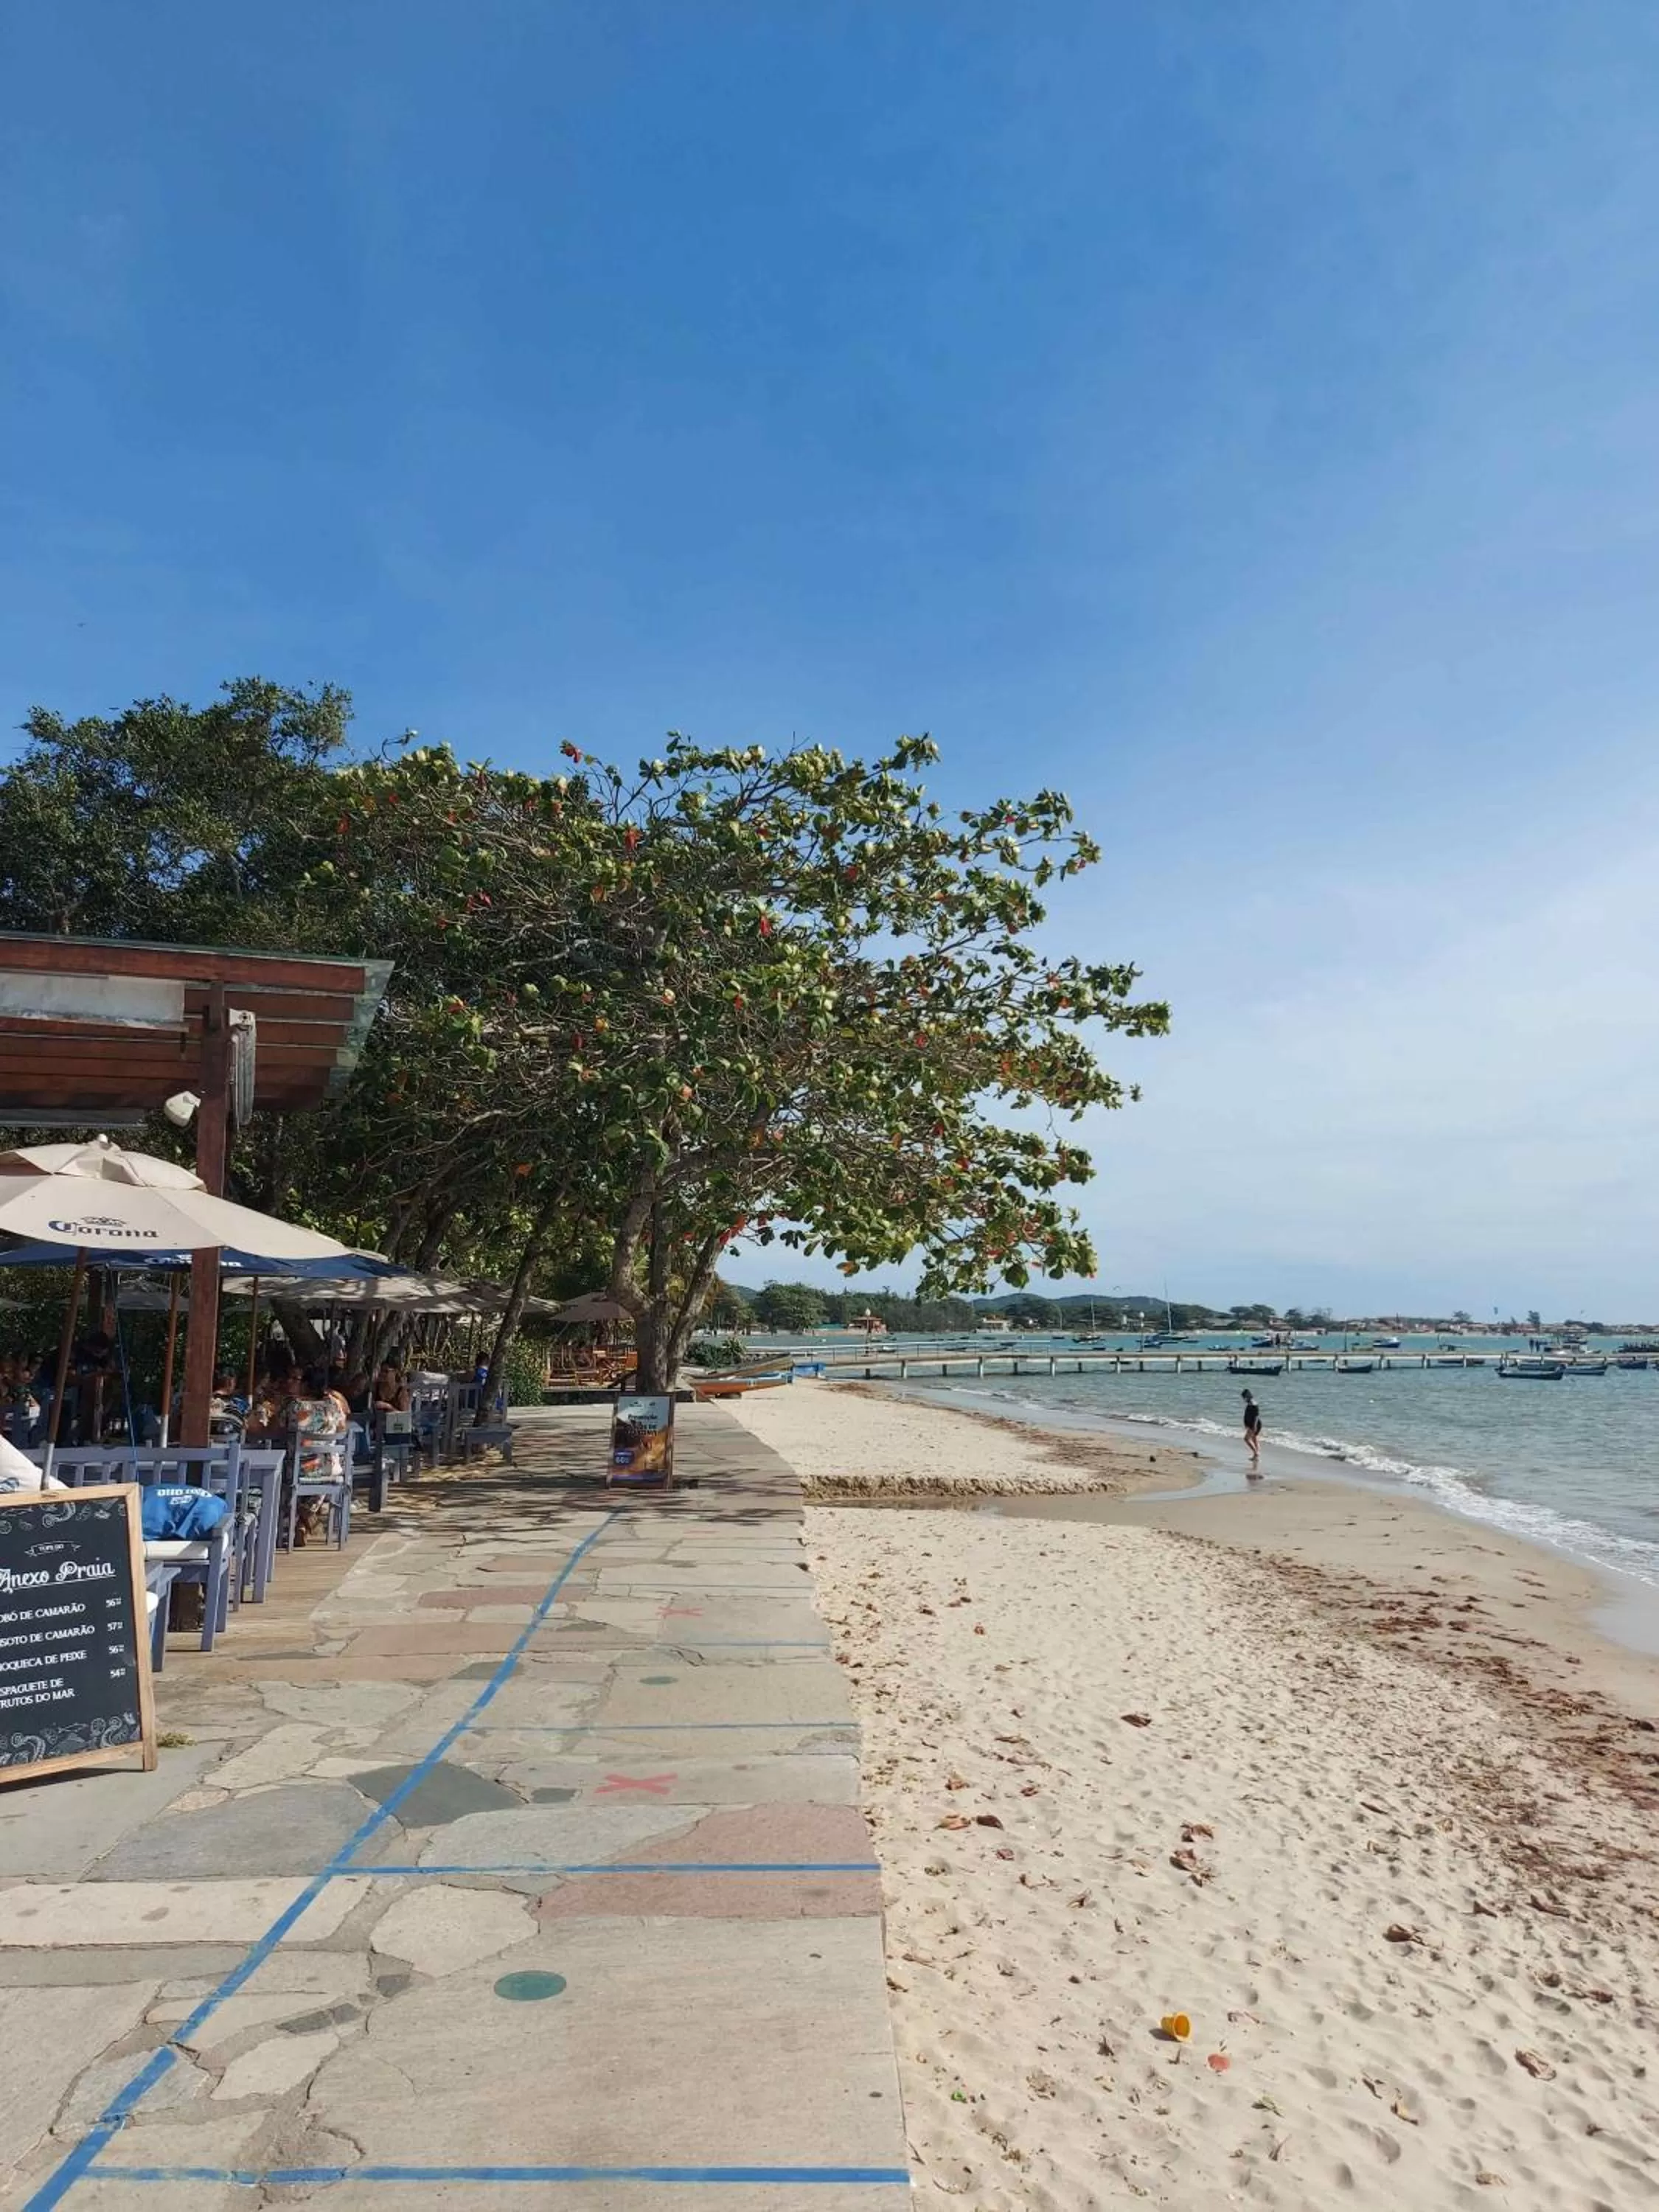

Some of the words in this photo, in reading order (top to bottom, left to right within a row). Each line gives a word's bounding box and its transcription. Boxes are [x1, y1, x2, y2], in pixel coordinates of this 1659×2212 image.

[48, 1220, 159, 1237] Corona
[0, 1568, 49, 1593] Anexo
[55, 1557, 116, 1581] Praia
[20, 1610, 34, 1621] DE
[35, 1602, 86, 1618] CAMARÃO
[29, 1632, 44, 1643] DE
[45, 1624, 96, 1641] CAMARÃO
[45, 1654, 59, 1664] DE
[60, 1649, 88, 1662] PEIXE
[0, 1680, 49, 1696] SPAGUETE
[50, 1677, 64, 1688] DE
[0, 1695, 33, 1708] RUTOS
[35, 1692, 51, 1703] DO
[52, 1688, 75, 1700] MAR
